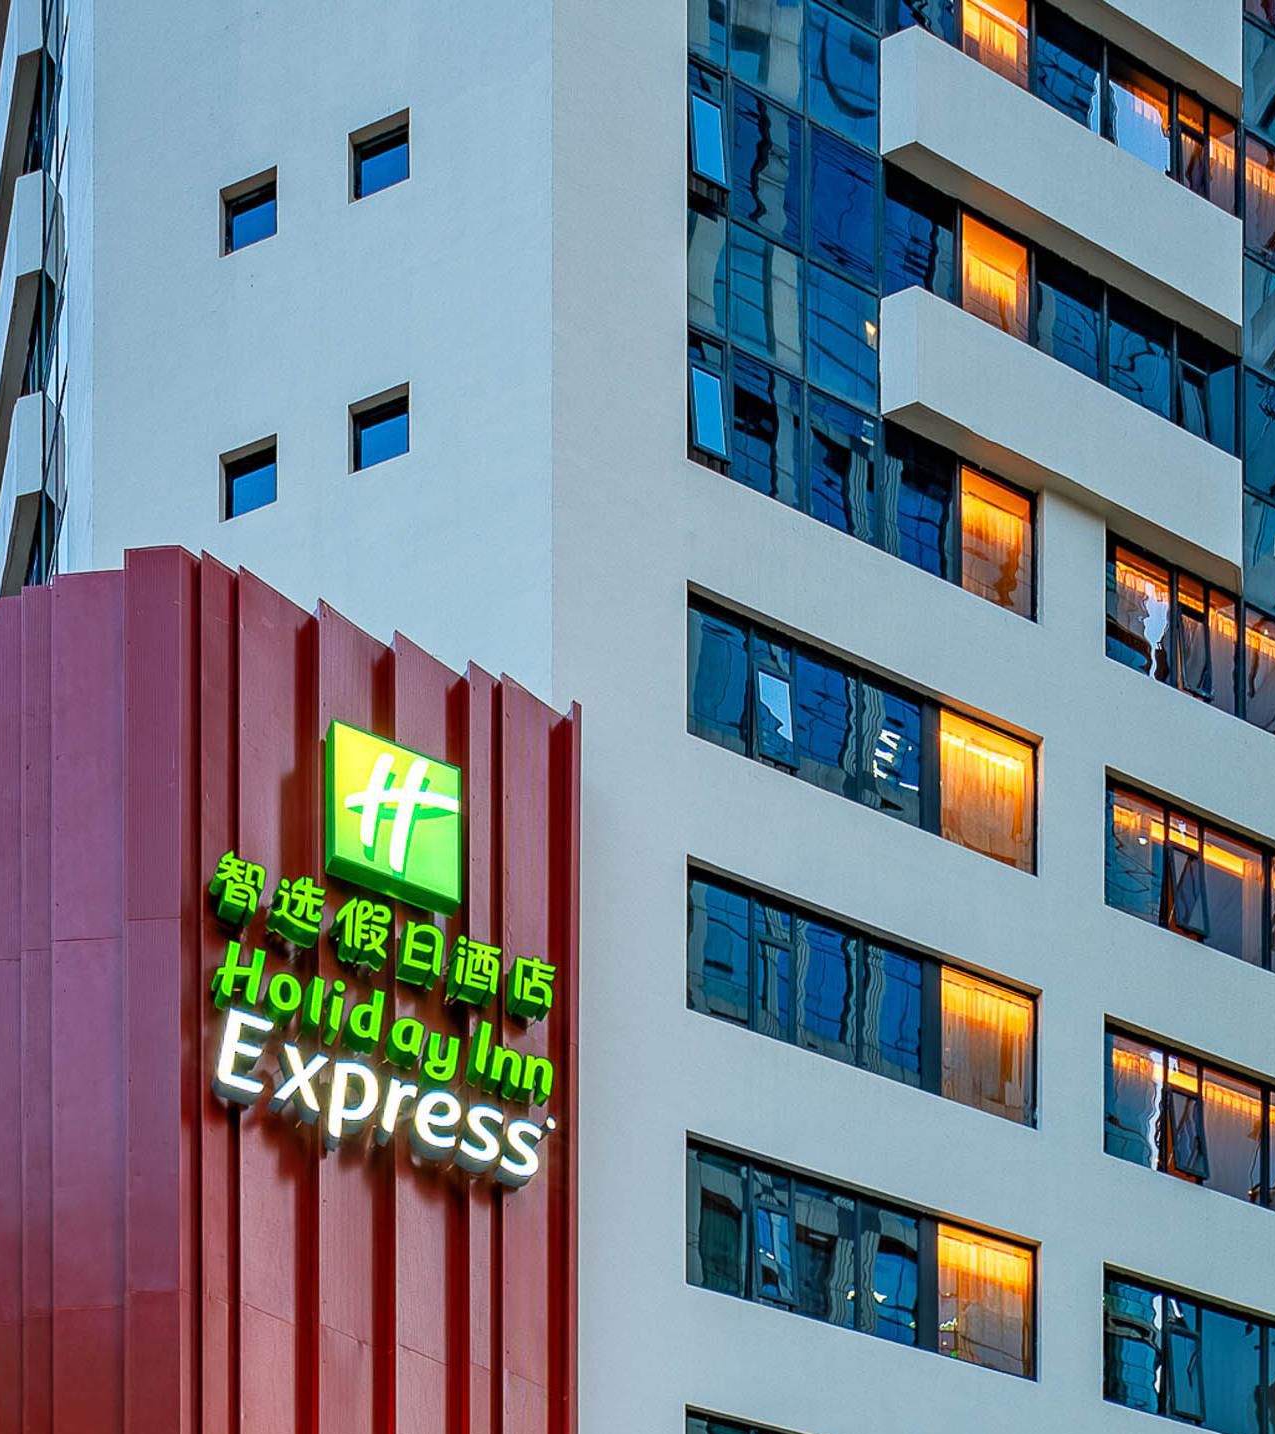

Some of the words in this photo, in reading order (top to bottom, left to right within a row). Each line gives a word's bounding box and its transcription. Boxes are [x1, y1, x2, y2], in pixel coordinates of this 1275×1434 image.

[212, 850, 556, 1014] 智选假日酒店
[215, 940, 461, 1082] Holiday
[472, 1020, 554, 1101] Inn
[216, 1006, 543, 1179] Express
